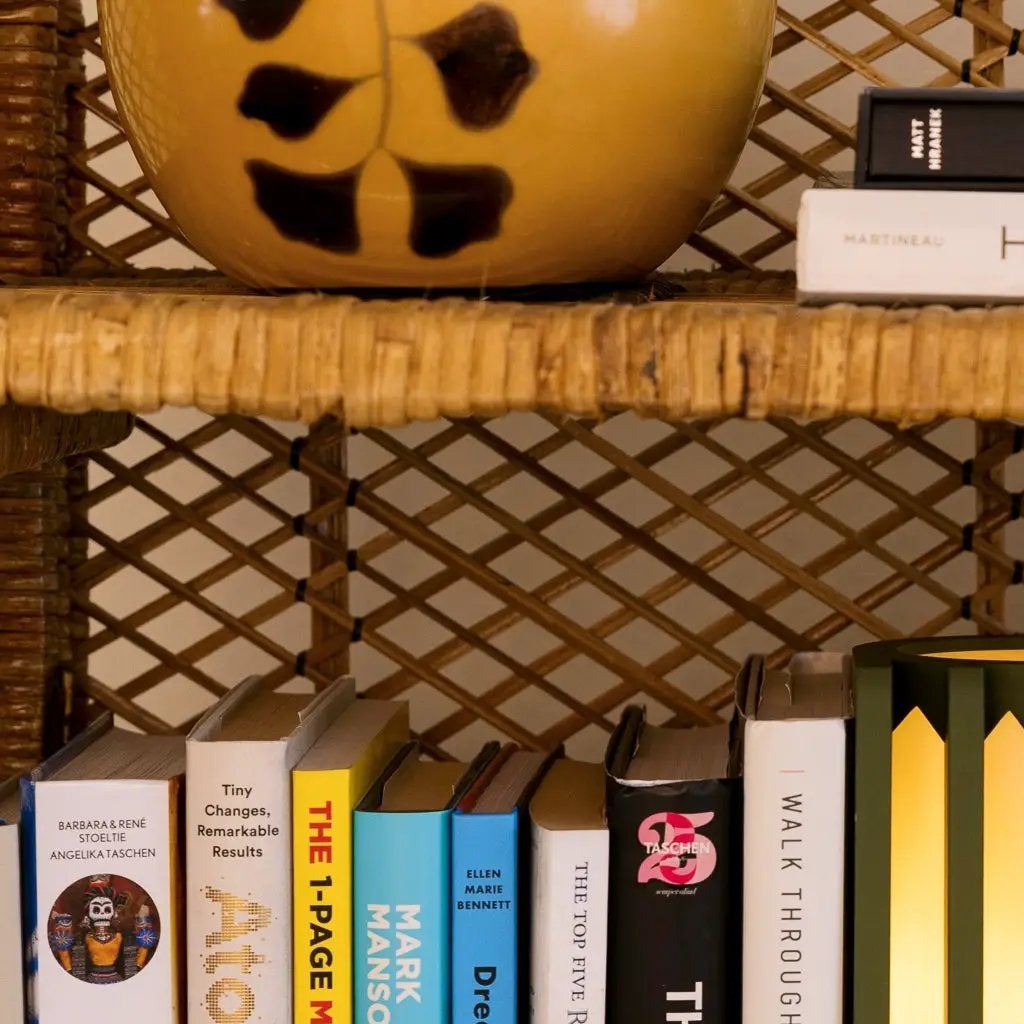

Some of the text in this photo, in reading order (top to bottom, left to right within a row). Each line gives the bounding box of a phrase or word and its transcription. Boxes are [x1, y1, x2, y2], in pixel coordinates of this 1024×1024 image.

[911, 118, 925, 159] MATT
[928, 108, 943, 170] HRANEK
[843, 233, 946, 247] MARTINEAU
[222, 784, 253, 799] Tiny
[204, 805, 271, 819] Changes,
[58, 817, 147, 831] BARBARA RENÉ
[78, 833, 126, 844] STOELTIE
[197, 825, 280, 838] Remarkable
[308, 801, 333, 864] THE
[781, 793, 803, 870] WALK
[50, 849, 156, 861] ANGELIKA TASCHEN
[212, 846, 263, 858] Results
[643, 842, 711, 854] TASCHEN
[466, 870, 501, 879] ELLEN
[574, 861, 590, 904] THE
[464, 885, 503, 895] MARIE
[457, 901, 511, 911] BENNETT
[309, 876, 334, 990] 1-PAGE
[573, 910, 588, 949] TOP
[395, 904, 422, 1004] MARK
[571, 957, 587, 1002] FIVE
